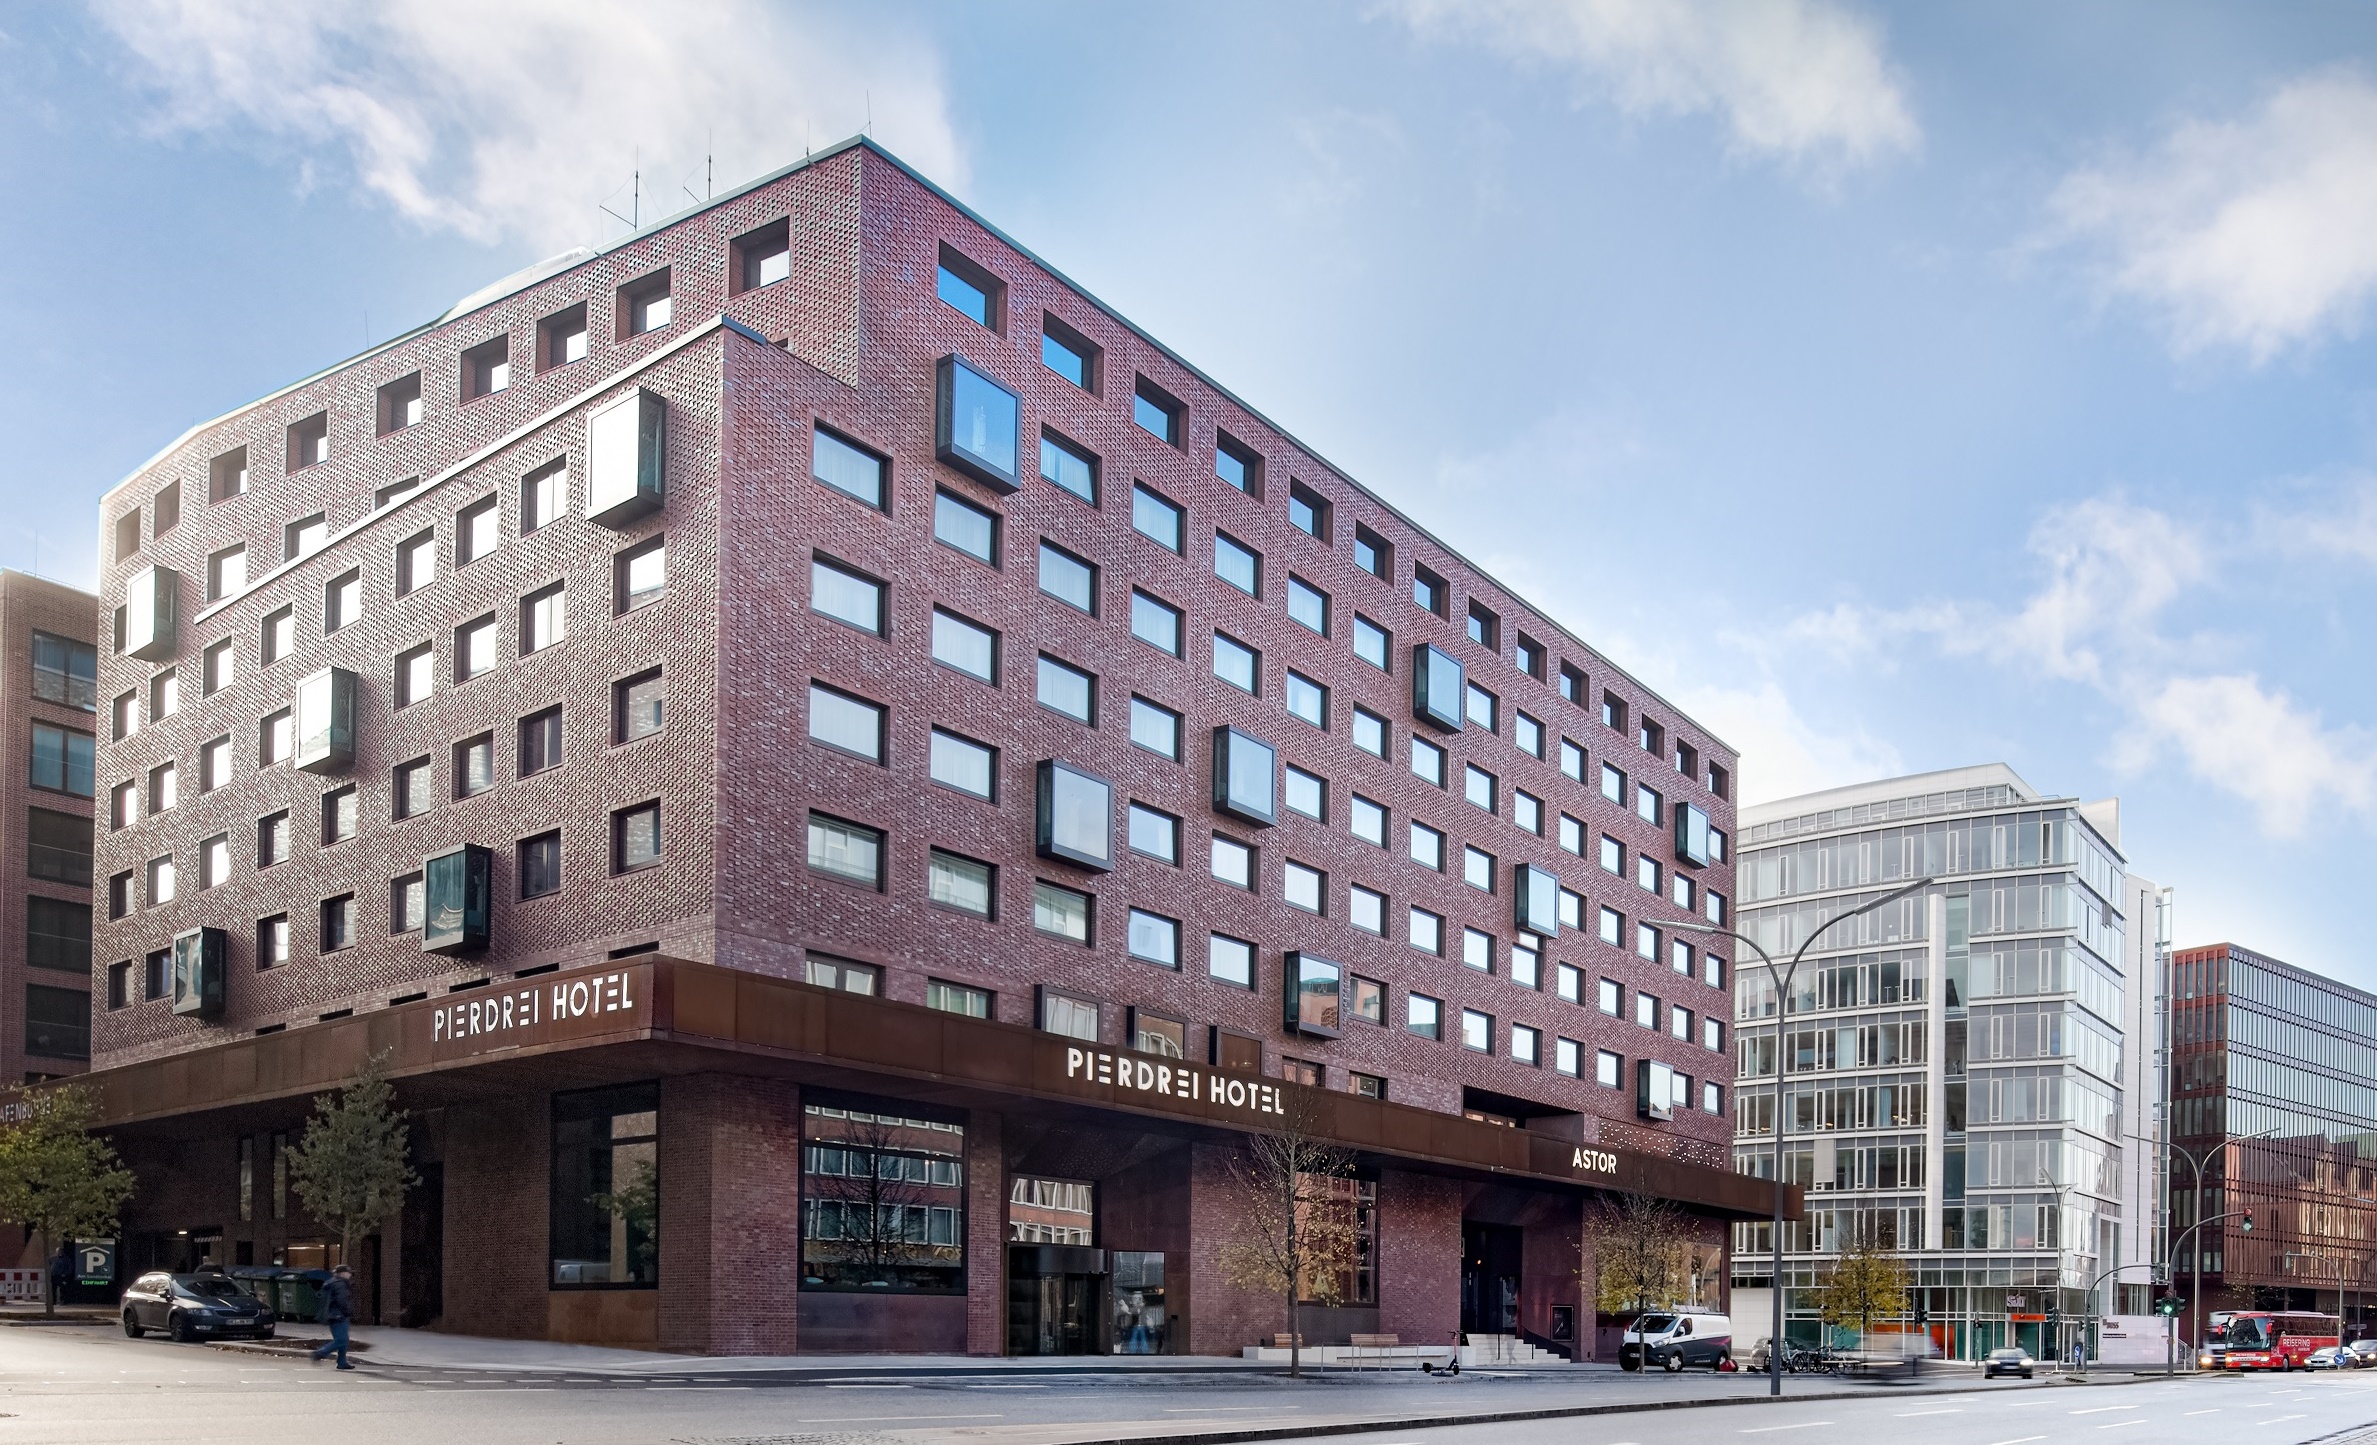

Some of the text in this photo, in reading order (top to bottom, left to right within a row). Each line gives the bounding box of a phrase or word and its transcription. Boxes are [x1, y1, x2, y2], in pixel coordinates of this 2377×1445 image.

[434, 972, 633, 1042] PIERDREI HOTEL
[1067, 1047, 1285, 1115] PIERDREI HOTEL
[1572, 1147, 1617, 1174] ASTOR
[86, 1252, 106, 1273] P
[2282, 1338, 2311, 1347] REISERING
